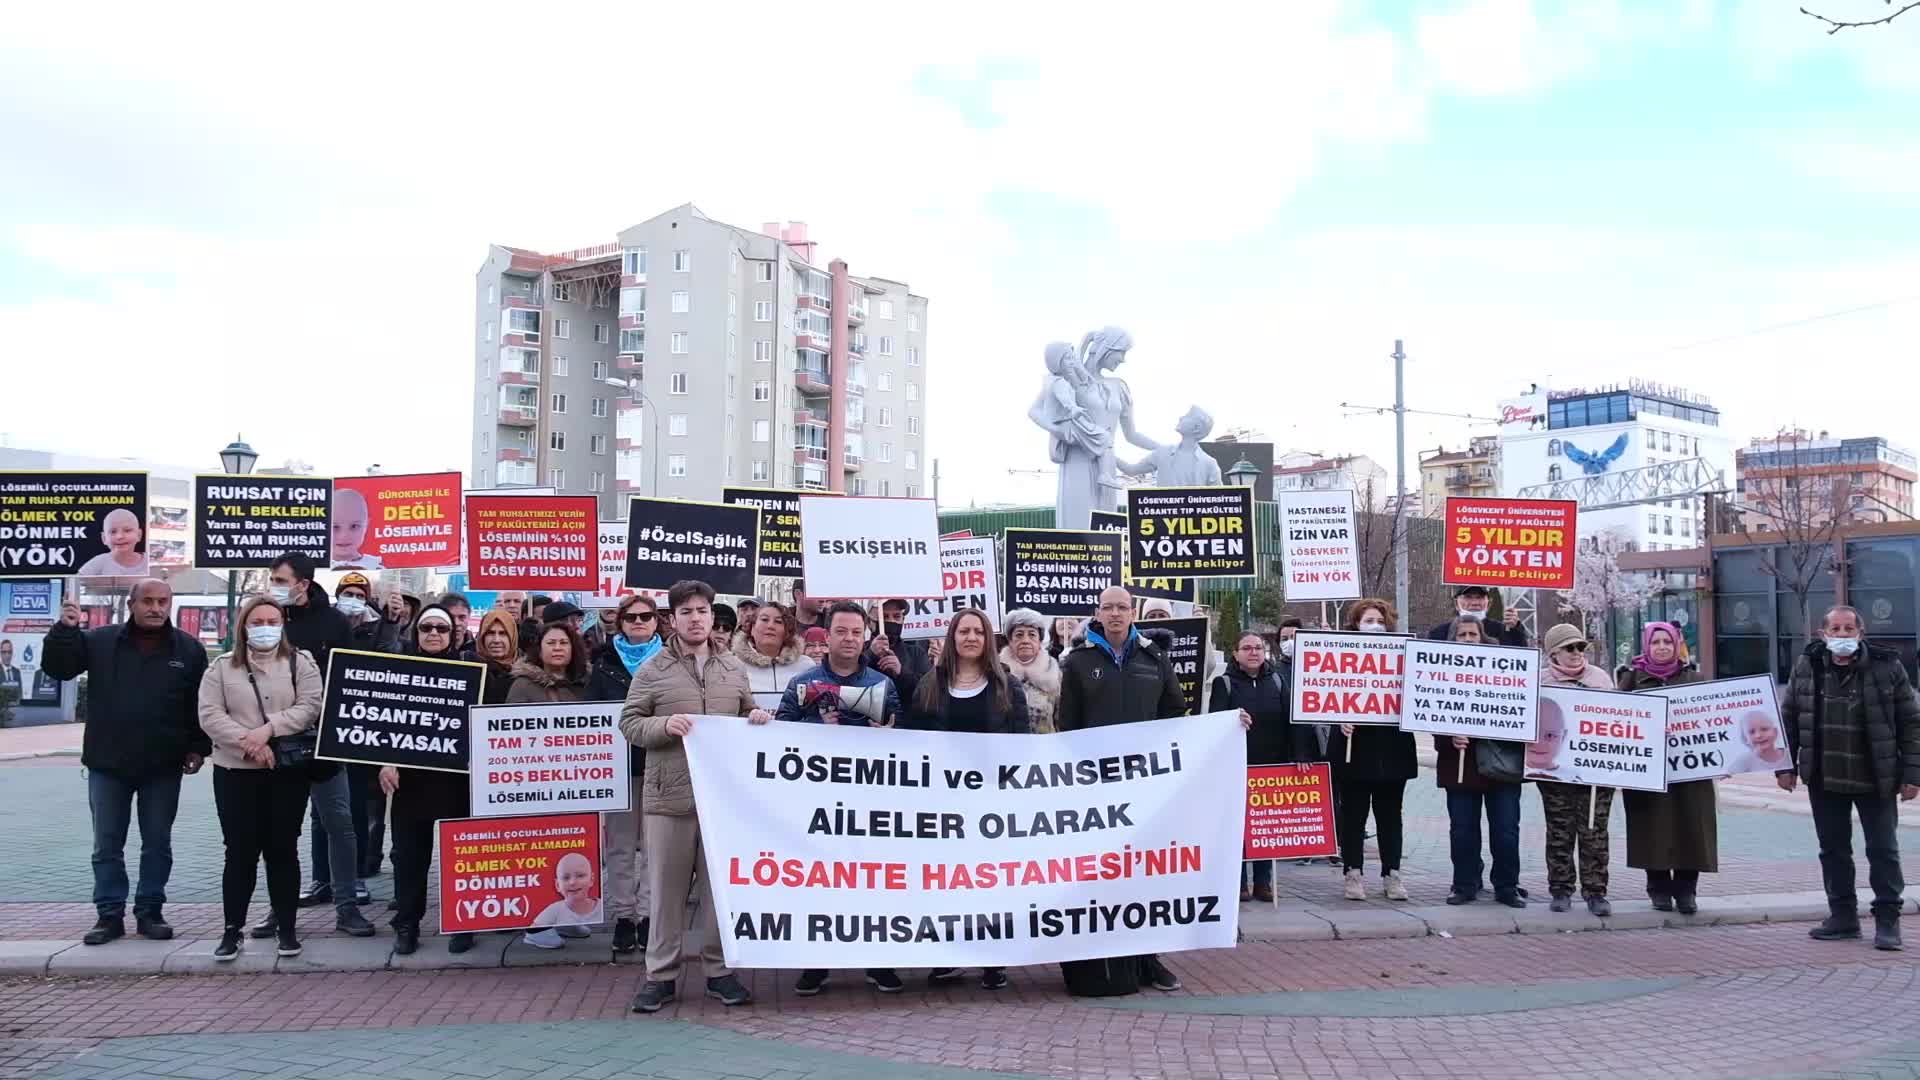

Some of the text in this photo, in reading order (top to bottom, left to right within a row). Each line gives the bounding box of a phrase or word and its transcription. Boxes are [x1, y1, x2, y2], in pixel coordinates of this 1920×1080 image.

[52, 484, 135, 493] ÇOCUKLARIMIZA
[207, 486, 283, 500] RUHSAT
[78, 496, 134, 504] ALMADAN
[1, 509, 95, 521] ÖLMEK YOK
[208, 505, 326, 517] 7 YIL BEKLEDİK
[384, 501, 445, 520] DEĞİL
[1288, 505, 1346, 515] HASTANESİZ
[207, 520, 326, 531] Yarısı Boş Sabrettik
[766, 515, 772, 524] 7
[1140, 519, 1155, 535] 5
[1163, 517, 1242, 535] YILDIR
[0, 524, 87, 539] DÖNMEK
[375, 523, 453, 538] LÖSEMİYLE
[479, 531, 585, 542] LÖSEMİNİN %100
[640, 526, 747, 548] #ÖzelSağlık
[1290, 527, 1348, 540] İZİN VAR
[1456, 527, 1563, 546] 5 YILDIR
[207, 535, 326, 545] YA TAM RUHSAT
[819, 537, 927, 558] ESKİŞEHİR
[1140, 536, 1243, 556] YÖKTEN
[0, 544, 75, 568] (YÖK)
[207, 550, 222, 558] YA
[226, 550, 243, 558] DA
[380, 542, 447, 555] SAVAŞALIM
[480, 547, 585, 563] BAŞARISINI
[1456, 545, 1562, 567] YÖKTEN
[481, 564, 586, 576] LÖSEV BULSUN
[1016, 562, 1112, 574] LÖSEMİNİN %100
[1016, 576, 1111, 591] BAŞARISINI
[1293, 569, 1351, 583] İZİN YÖK
[14, 597, 47, 608] DEVA
[1016, 592, 1099, 604] LÖSEV BULSU
[1304, 652, 1404, 675] PARALI
[1416, 652, 1486, 668] RUHSAT
[345, 669, 467, 691] KENDİNE ELLERE
[1303, 677, 1402, 688] HASTANESİ OLAN
[1416, 671, 1527, 687] 7 YIL BEKLEDİK
[342, 688, 369, 697] YATAK
[372, 691, 407, 700] RUHSAT
[409, 695, 445, 704] DOKTOR
[1415, 685, 1526, 700] Yarısı Boş Sabrettik
[1691, 688, 1762, 703] ÇOCUKLARIMIZA
[1302, 691, 1401, 715] BAKAN
[1415, 699, 1526, 716] YA TAM RUHSAT
[1674, 699, 1763, 716] RUHSAT ALMADAN
[488, 716, 612, 731] NEDEN NEDEN
[1414, 712, 1525, 728] YA DA YARIM HAYAT
[1705, 716, 1733, 727] YOK
[1580, 720, 1644, 740] DEĞİL
[336, 726, 459, 754] YÖK-YASAK
[488, 732, 613, 749] TAM 7 SENEDİR
[1668, 731, 1730, 747] ÖNMEK
[1570, 739, 1653, 757] LÖSEMİYLE
[512, 756, 544, 764] YATAK
[566, 753, 613, 762] HASTANE
[1574, 758, 1646, 773] SAVAŞALIM
[1668, 749, 1724, 771] YÖK)
[756, 743, 1183, 790] LÖSEMİLİ ve KANSERLİ
[489, 766, 613, 786] BOŞ BEKLİYOR
[1248, 776, 1319, 790] ÇOCUKLAR
[489, 788, 614, 803] LÖSEMİLİ AİLELER
[1249, 790, 1320, 806] ÖLÜYOR
[808, 802, 1134, 840] AİLELER OLARAK
[454, 826, 586, 841] LÖSEMİLİ ÇOCUKLARIMIZA
[454, 840, 585, 855] TAM RUHSAT ALMADAN
[1252, 835, 1325, 849] DÜŞÜNÜYOR
[455, 857, 548, 873] ÖLMEK YOK
[729, 852, 907, 890] LÖSANTE
[455, 874, 540, 891] DÖNMEK
[456, 895, 529, 922] (YÖK)
[731, 896, 1221, 944] AM RUHSATINI İSTİYORUZ
